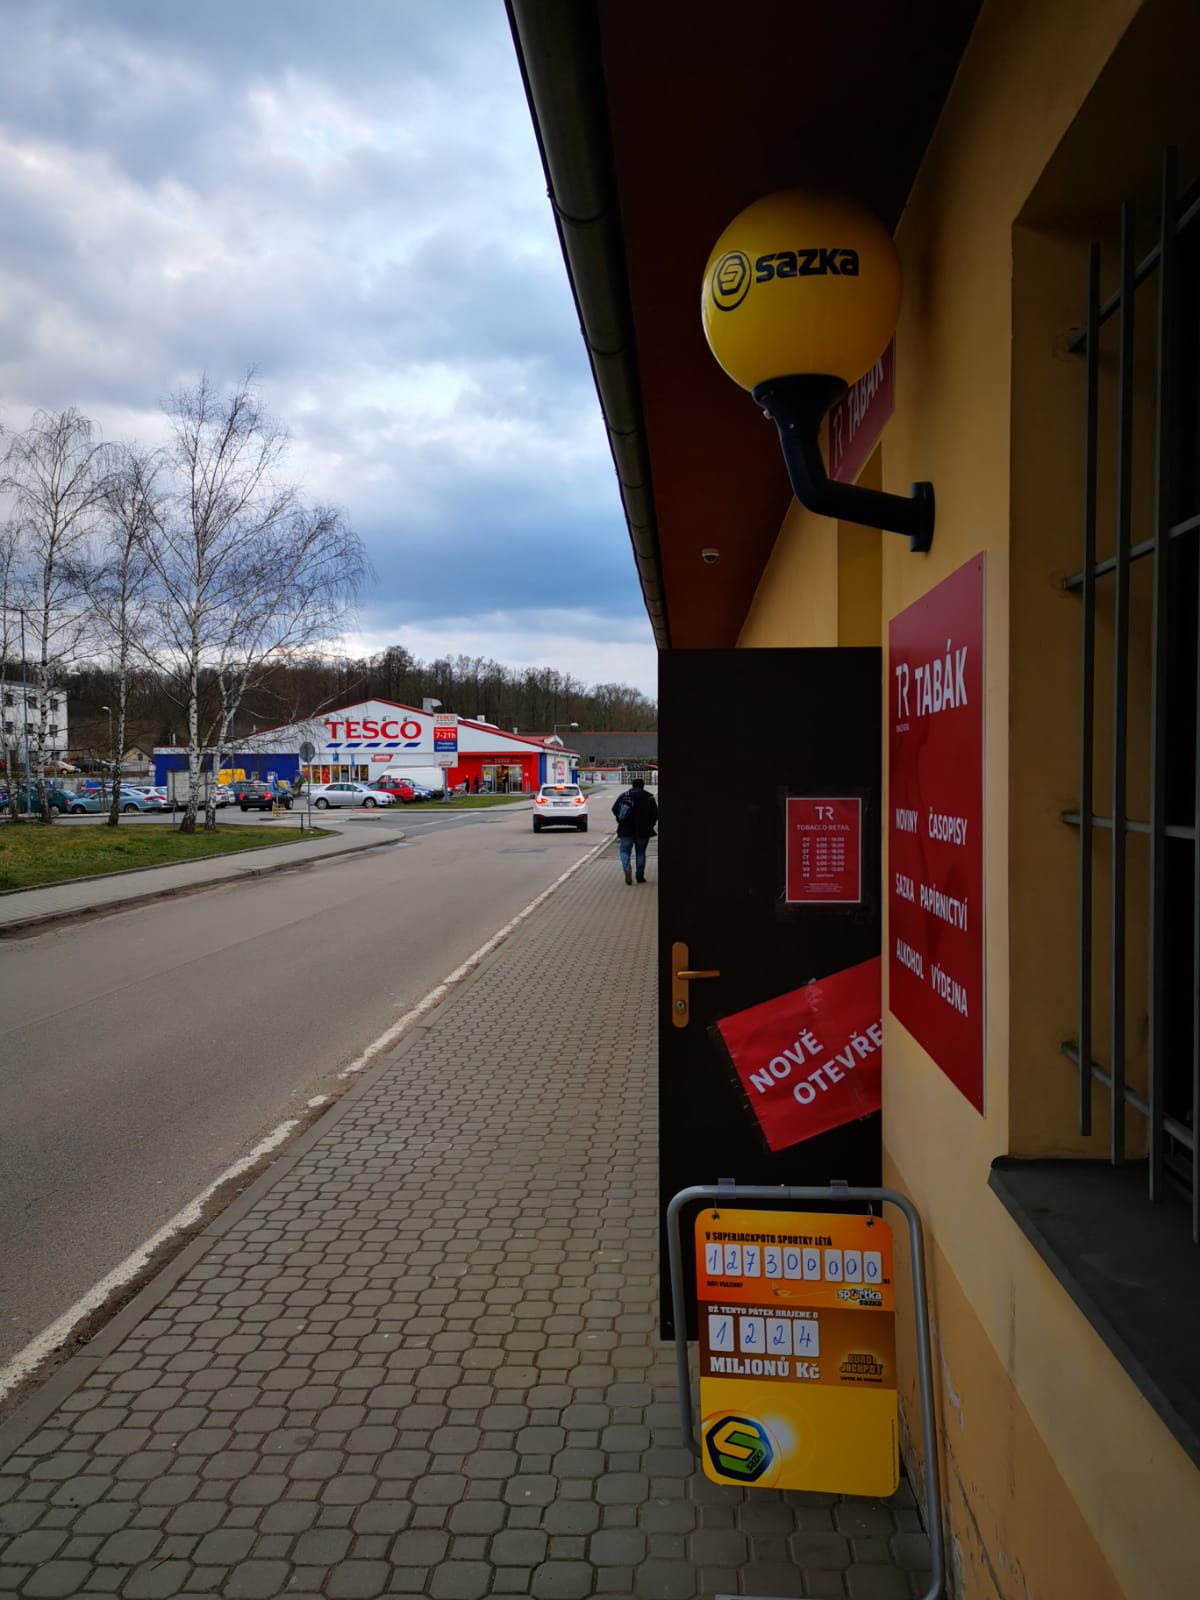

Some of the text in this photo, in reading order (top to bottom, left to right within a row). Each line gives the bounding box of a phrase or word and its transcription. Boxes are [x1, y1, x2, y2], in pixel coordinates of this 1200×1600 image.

[756, 248, 859, 283] sazka
[895, 638, 968, 719] TR TABÁK
[324, 721, 422, 740] TESCO
[815, 806, 834, 821] TR
[896, 806, 968, 846] NOVINY ČASOPISY
[896, 872, 968, 932] SAZKA PAPÍRNICTVÍ
[896, 937, 968, 1018] ALKOHOL VÝDEJNA
[749, 1028, 824, 1094] NOVĚ
[793, 1018, 884, 1105] OTEVŘE
[705, 1231, 832, 1247] V SUPERJACKPOTU SPORTKY LÉTÁ
[721, 1306, 747, 1315] TENTO
[748, 1306, 774, 1317] PÁTEK
[709, 1356, 820, 1379] MILIONŮ Kč
